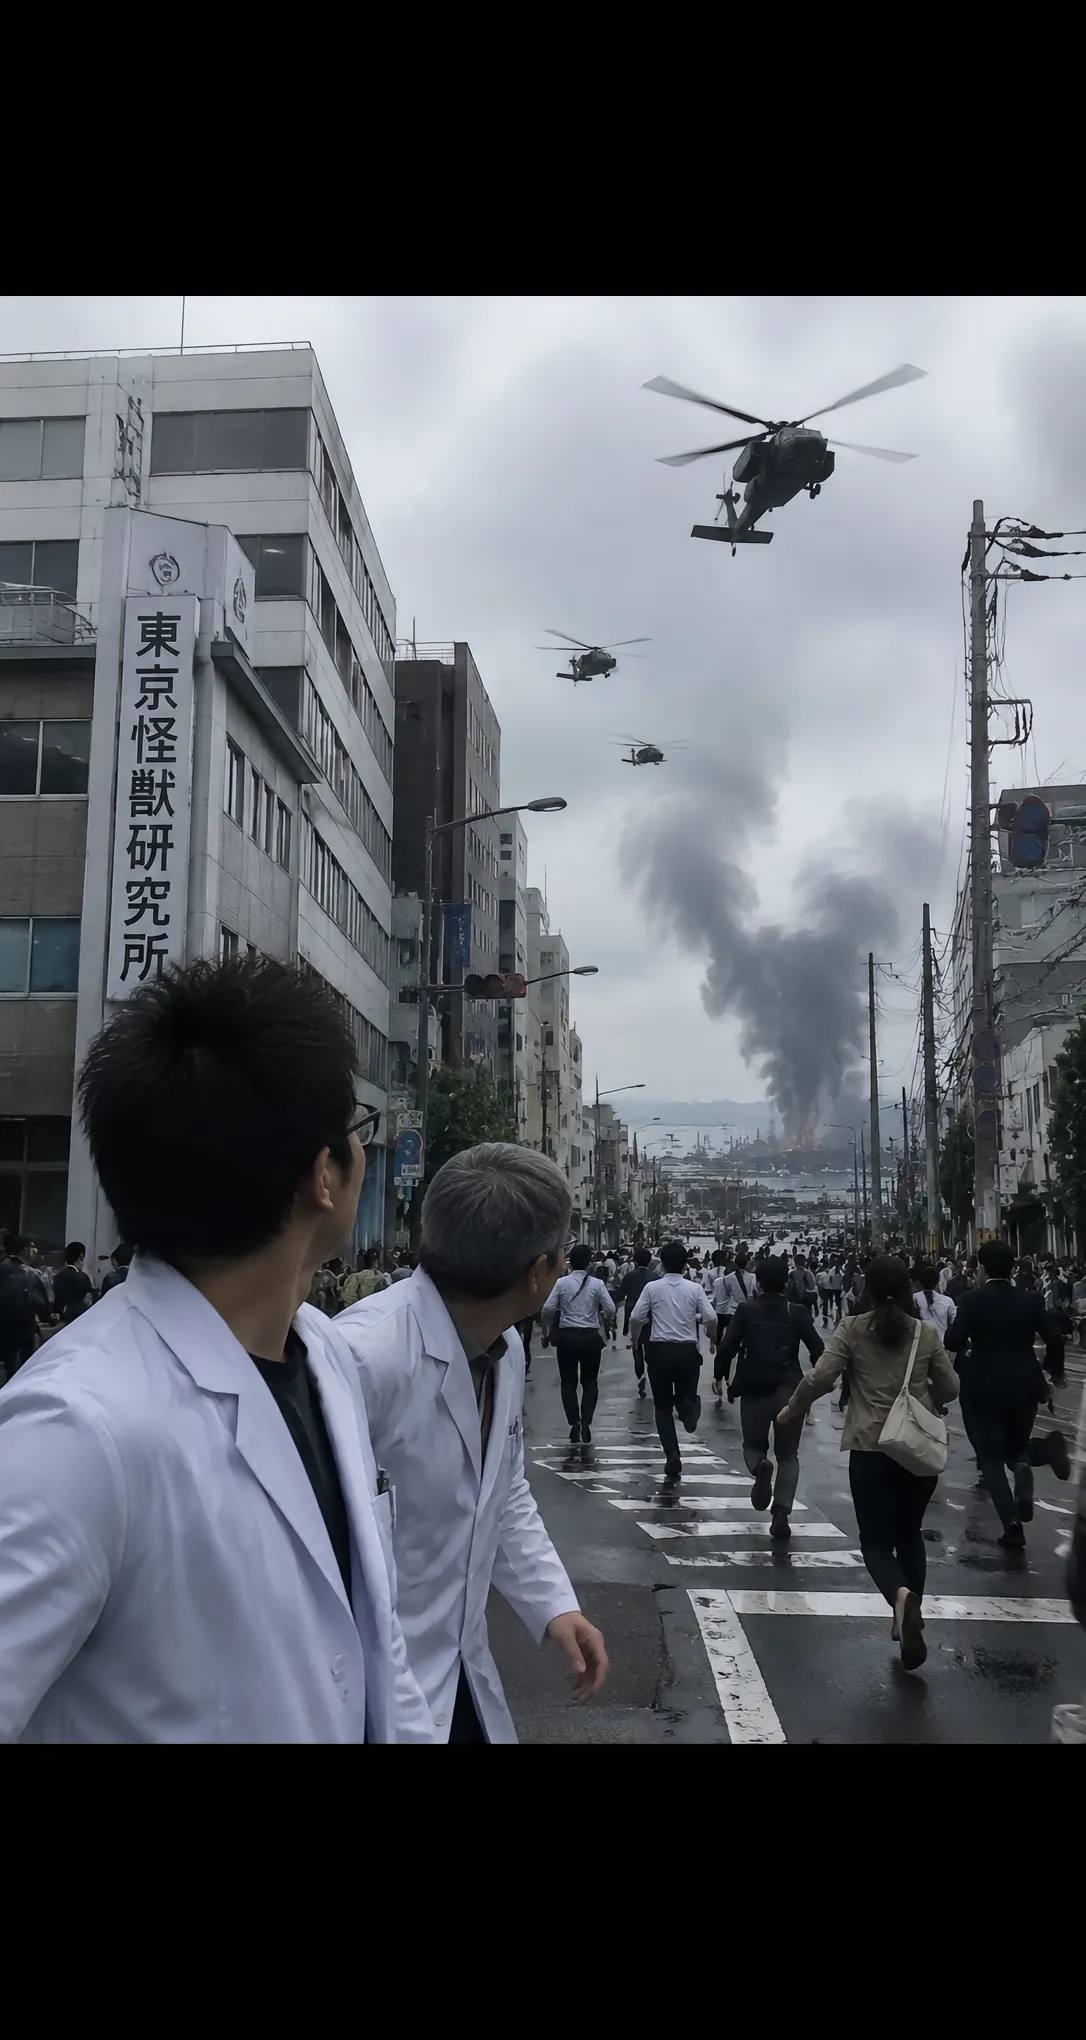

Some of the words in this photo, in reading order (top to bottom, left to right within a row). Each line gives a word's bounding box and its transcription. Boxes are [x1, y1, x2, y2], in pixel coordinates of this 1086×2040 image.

[120, 611, 181, 982] 東京怪獣研究所
